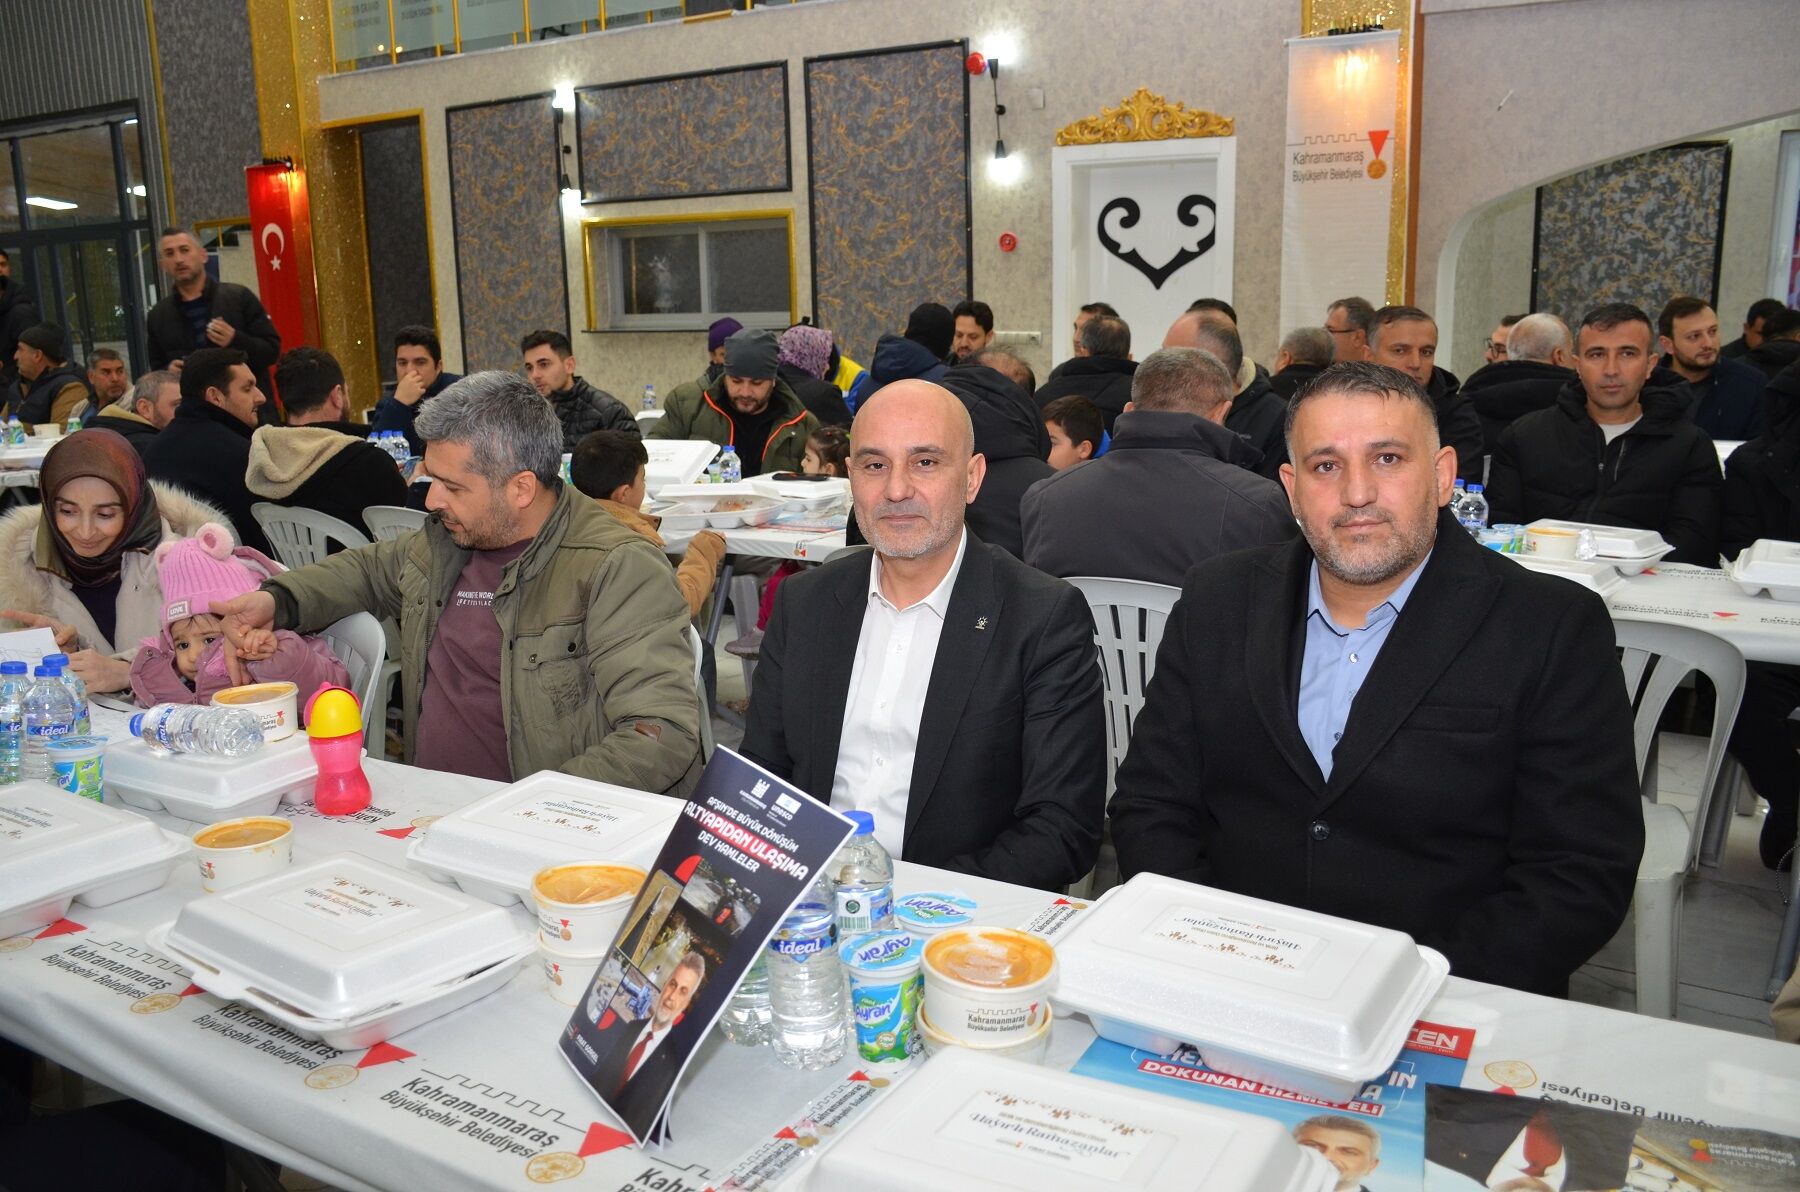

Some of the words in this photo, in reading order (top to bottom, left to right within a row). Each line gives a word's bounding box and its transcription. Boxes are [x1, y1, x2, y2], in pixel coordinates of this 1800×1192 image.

[1293, 150, 1364, 165] Kahramanmaraş
[170, 606, 183, 615] LOVE
[40, 724, 69, 736] ideal
[770, 804, 794, 821] unesco
[684, 801, 753, 848] ALTYAPIDAN
[750, 837, 810, 881] ULAŞIMA
[736, 811, 763, 834] BÜYÜK
[760, 827, 800, 853] DÖNÜŞÜM
[697, 830, 718, 849] DEV
[715, 840, 761, 873] HAMLELER
[904, 899, 965, 917] Ayran
[779, 938, 821, 954] ideal
[857, 937, 911, 962] Ayran
[41, 953, 96, 989] Büyükşehir
[93, 972, 146, 1001] Belediyesi
[63, 943, 172, 991] Kahramanmaraş
[856, 1003, 890, 1021] Ayran
[192, 1014, 260, 1044] Büyükşehir
[255, 1040, 325, 1071] Belediyesi
[215, 1003, 343, 1060] Kahramanmaraş
[1143, 1061, 1257, 1092] DOKUNAN
[402, 1077, 560, 1147] Kahramanmaraş
[1541, 1081, 1646, 1117] Belediyesi
[380, 1090, 462, 1128] Büyükşehir
[458, 1120, 542, 1160] Belediyesi
